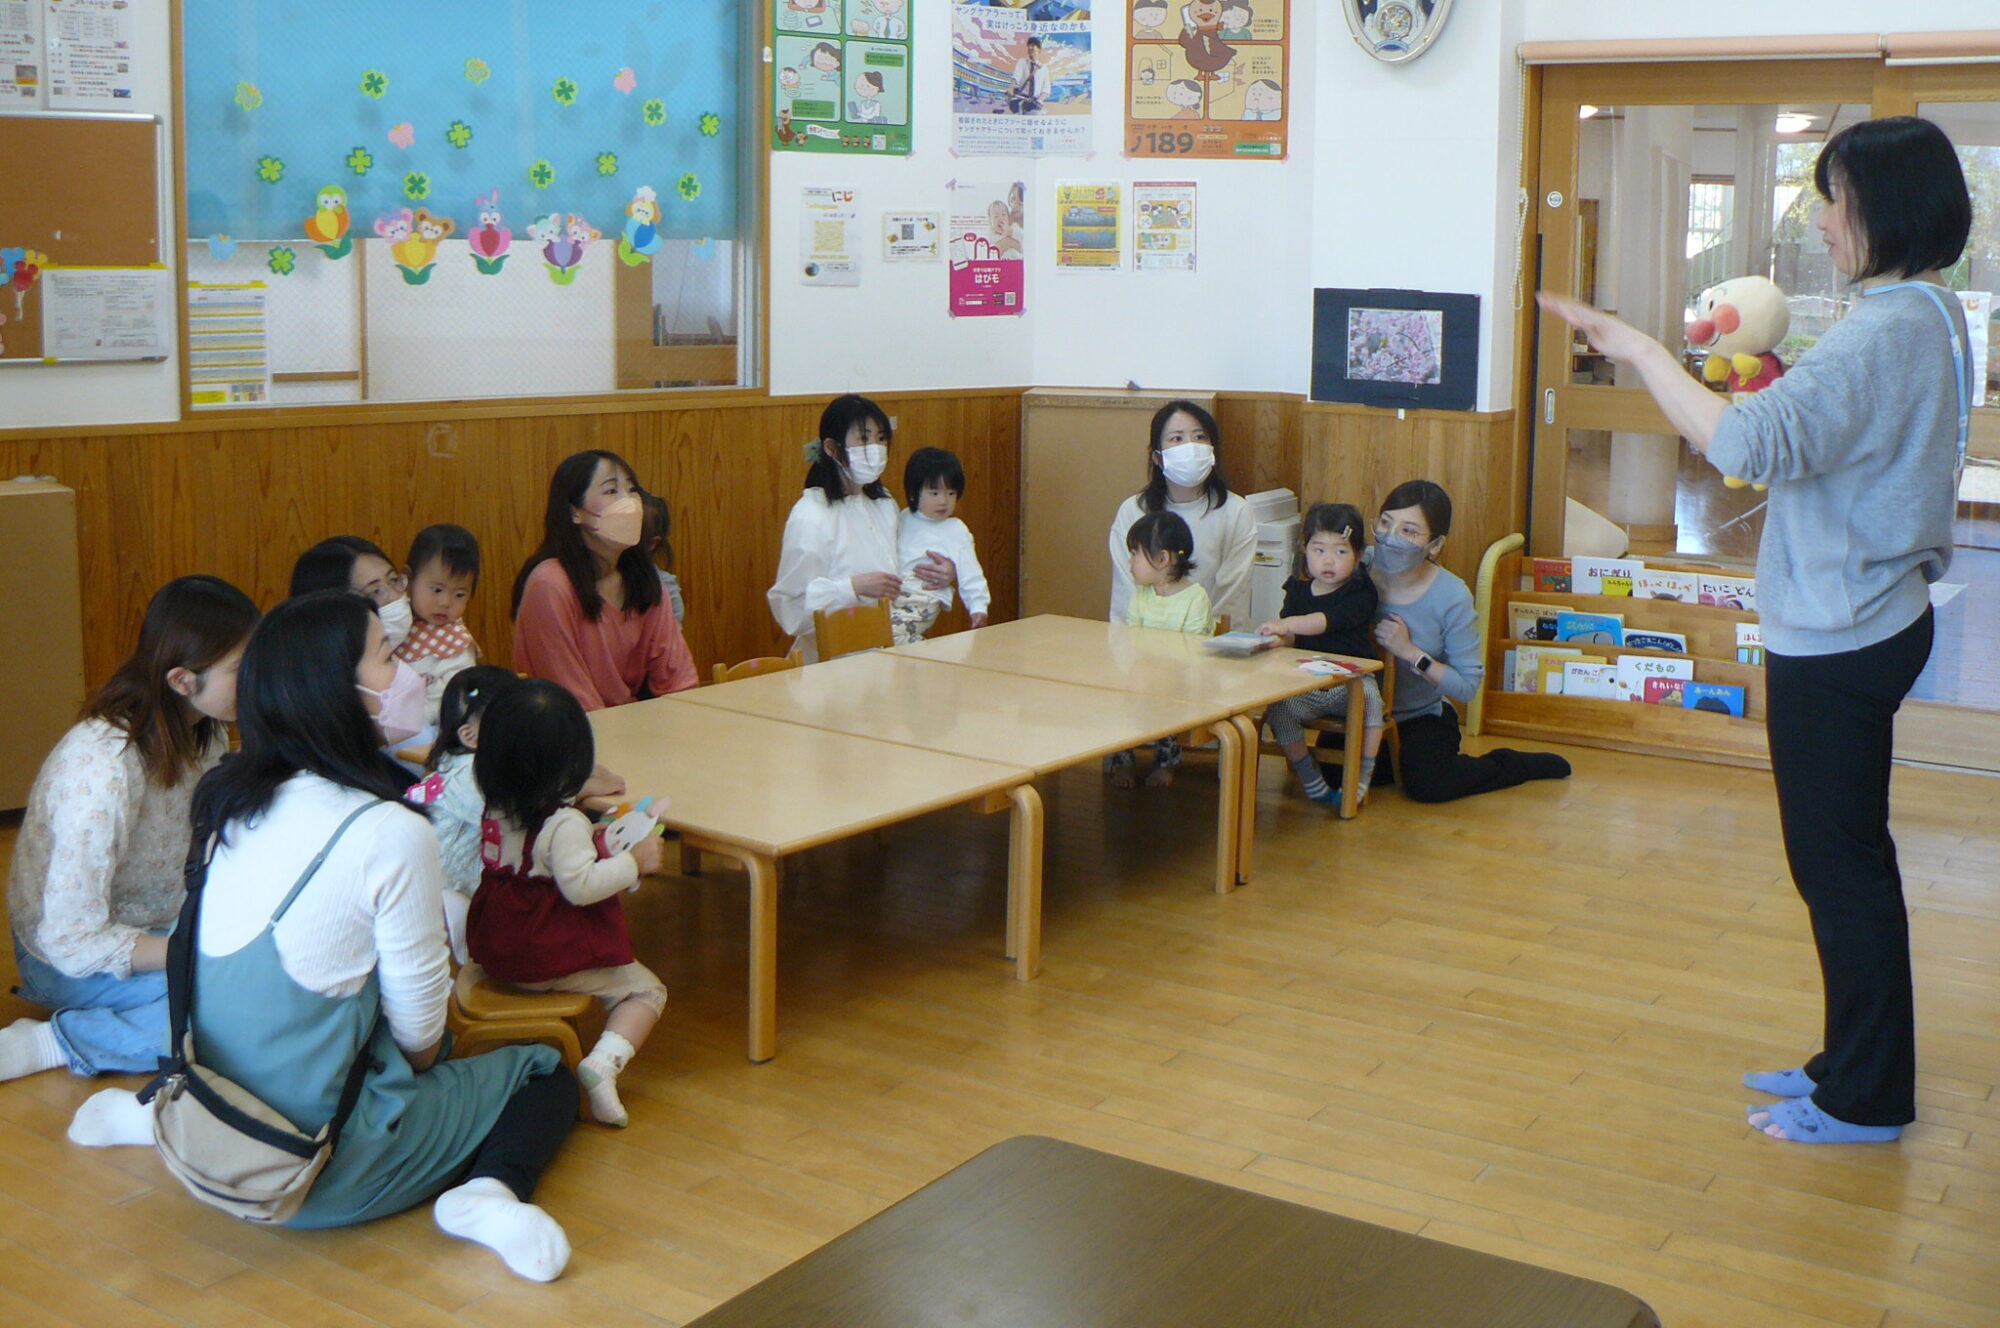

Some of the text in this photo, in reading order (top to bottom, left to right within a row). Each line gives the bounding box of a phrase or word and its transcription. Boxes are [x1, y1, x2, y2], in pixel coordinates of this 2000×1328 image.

[1146, 132, 1194, 153] 189
[831, 190, 853, 202] にじ
[1588, 567, 1631, 578] おにぎり
[1703, 584, 1754, 598] たいこ どん
[1635, 662, 1676, 673] くだもの
